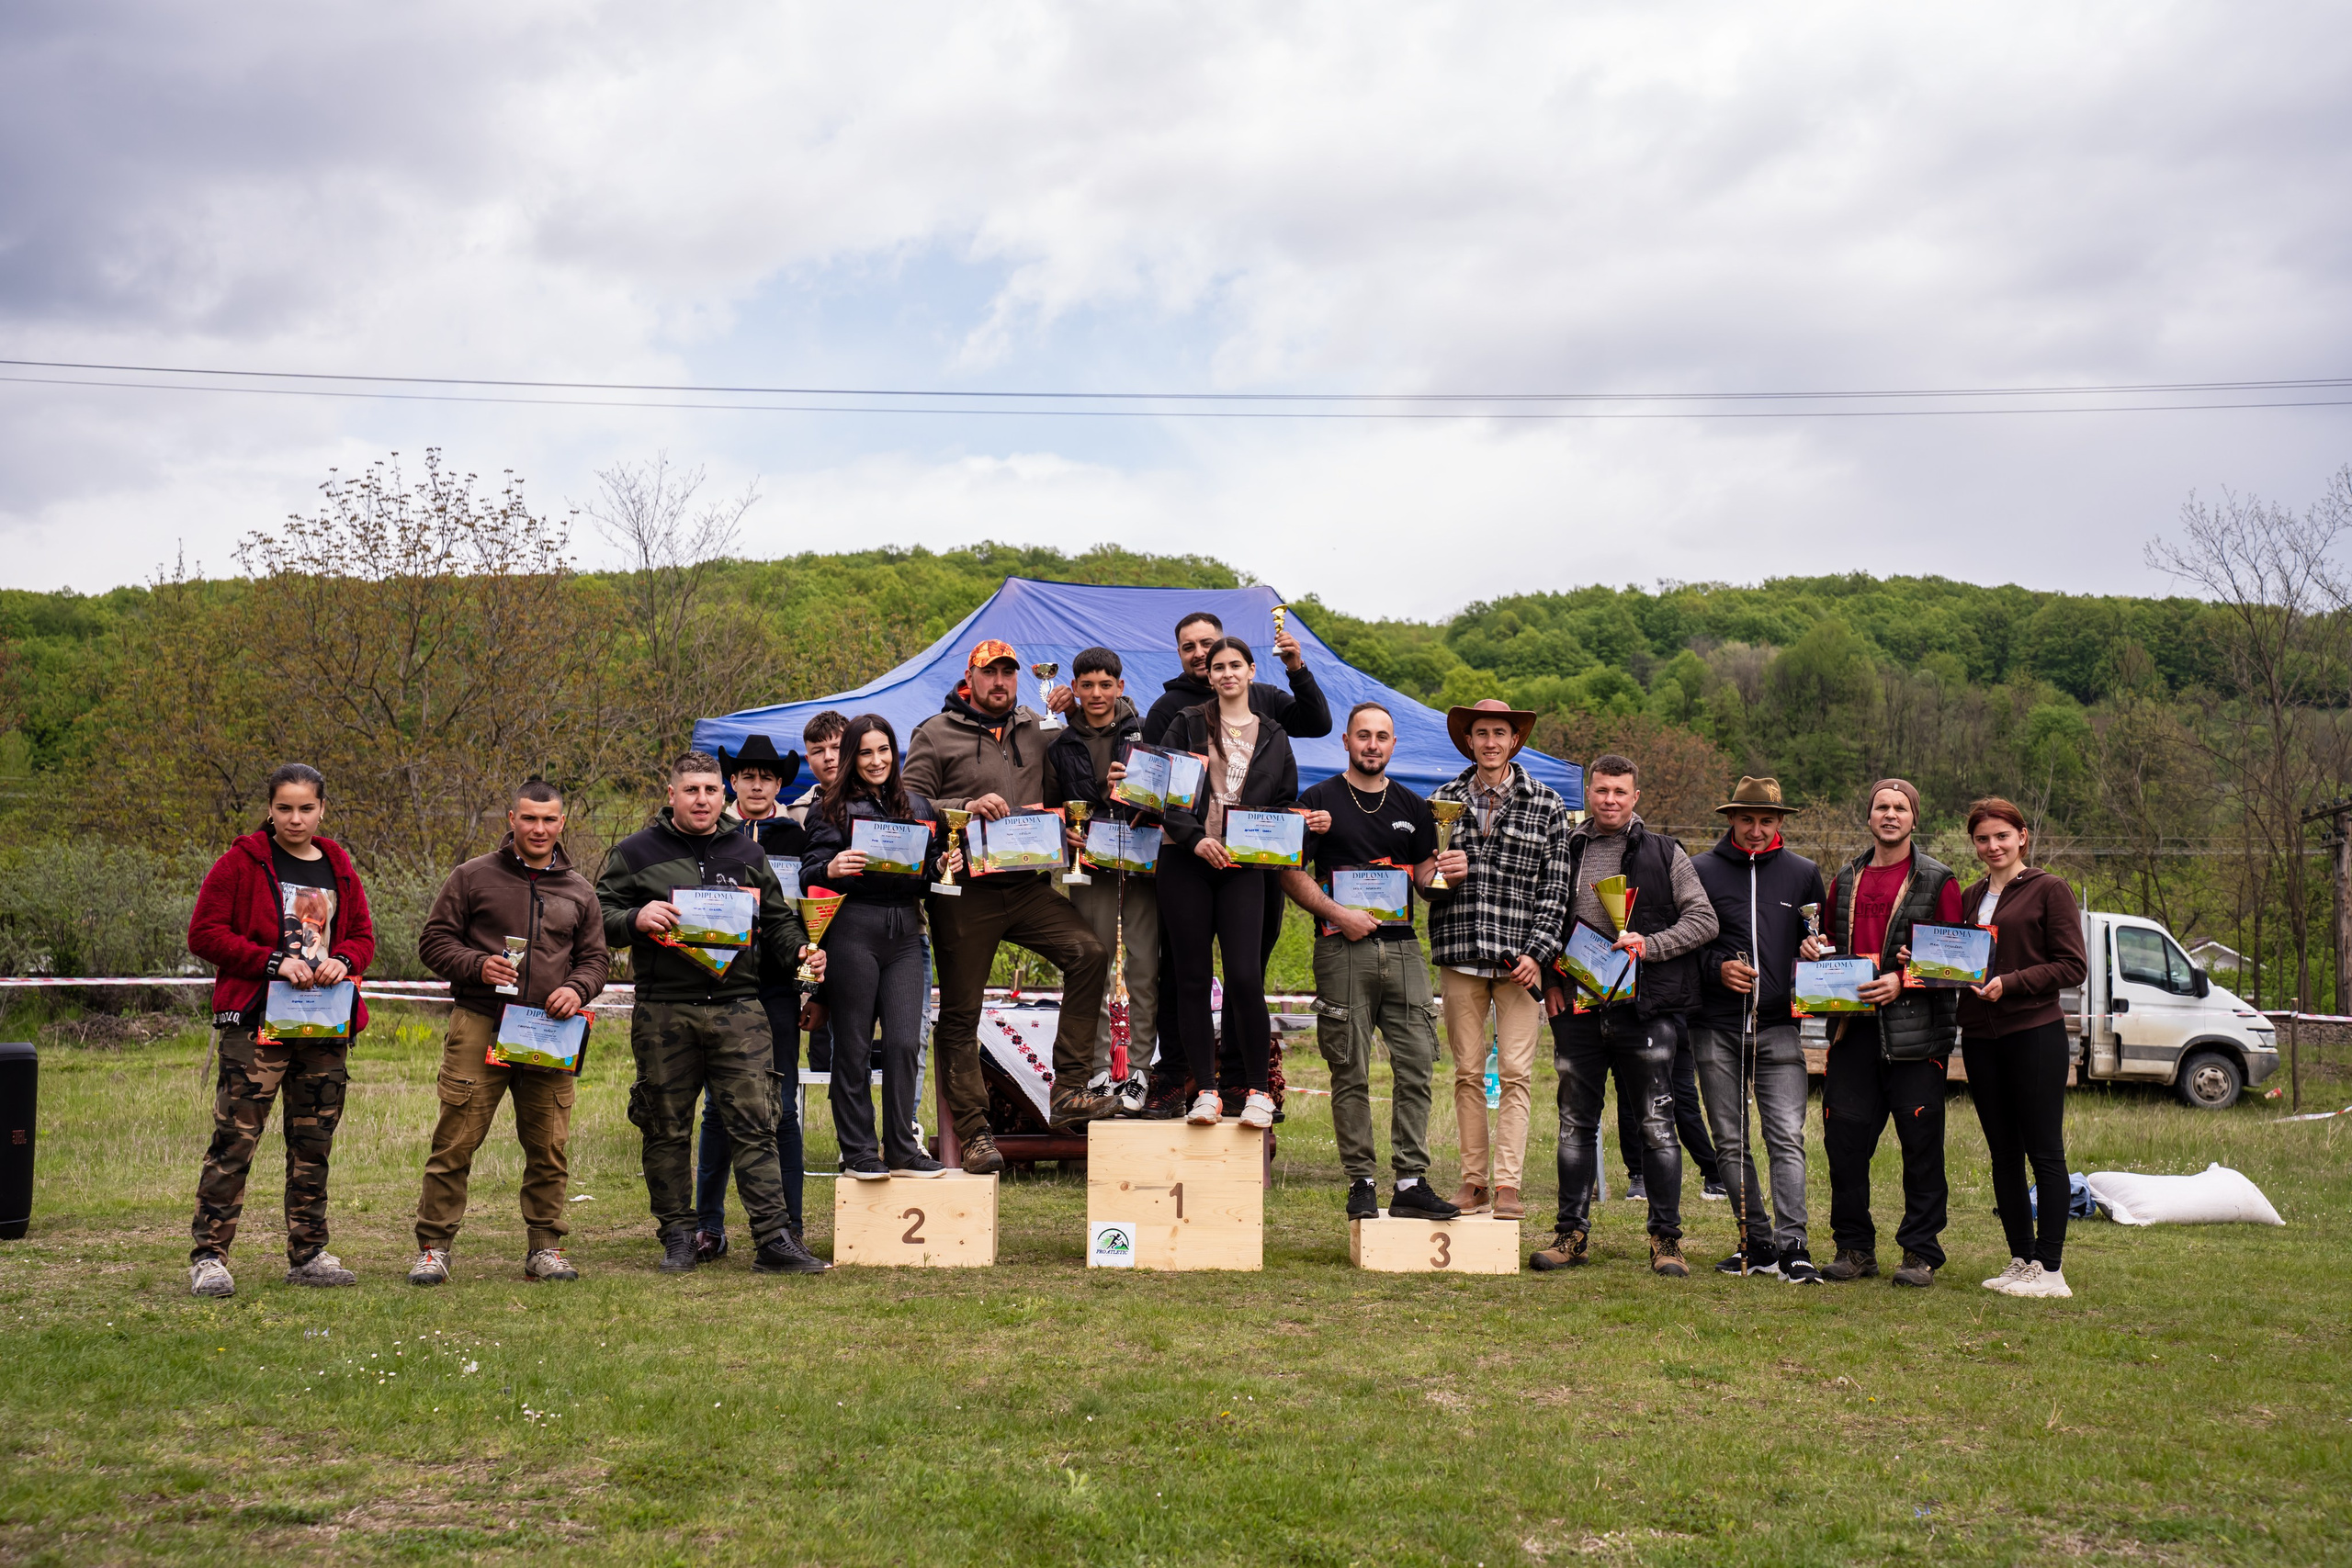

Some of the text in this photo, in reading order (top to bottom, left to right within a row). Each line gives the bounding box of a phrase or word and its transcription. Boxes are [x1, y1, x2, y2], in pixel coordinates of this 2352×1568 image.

[1170, 1182, 1183, 1219] 1
[902, 1207, 925, 1245] 2
[1430, 1232, 1451, 1269] 3
